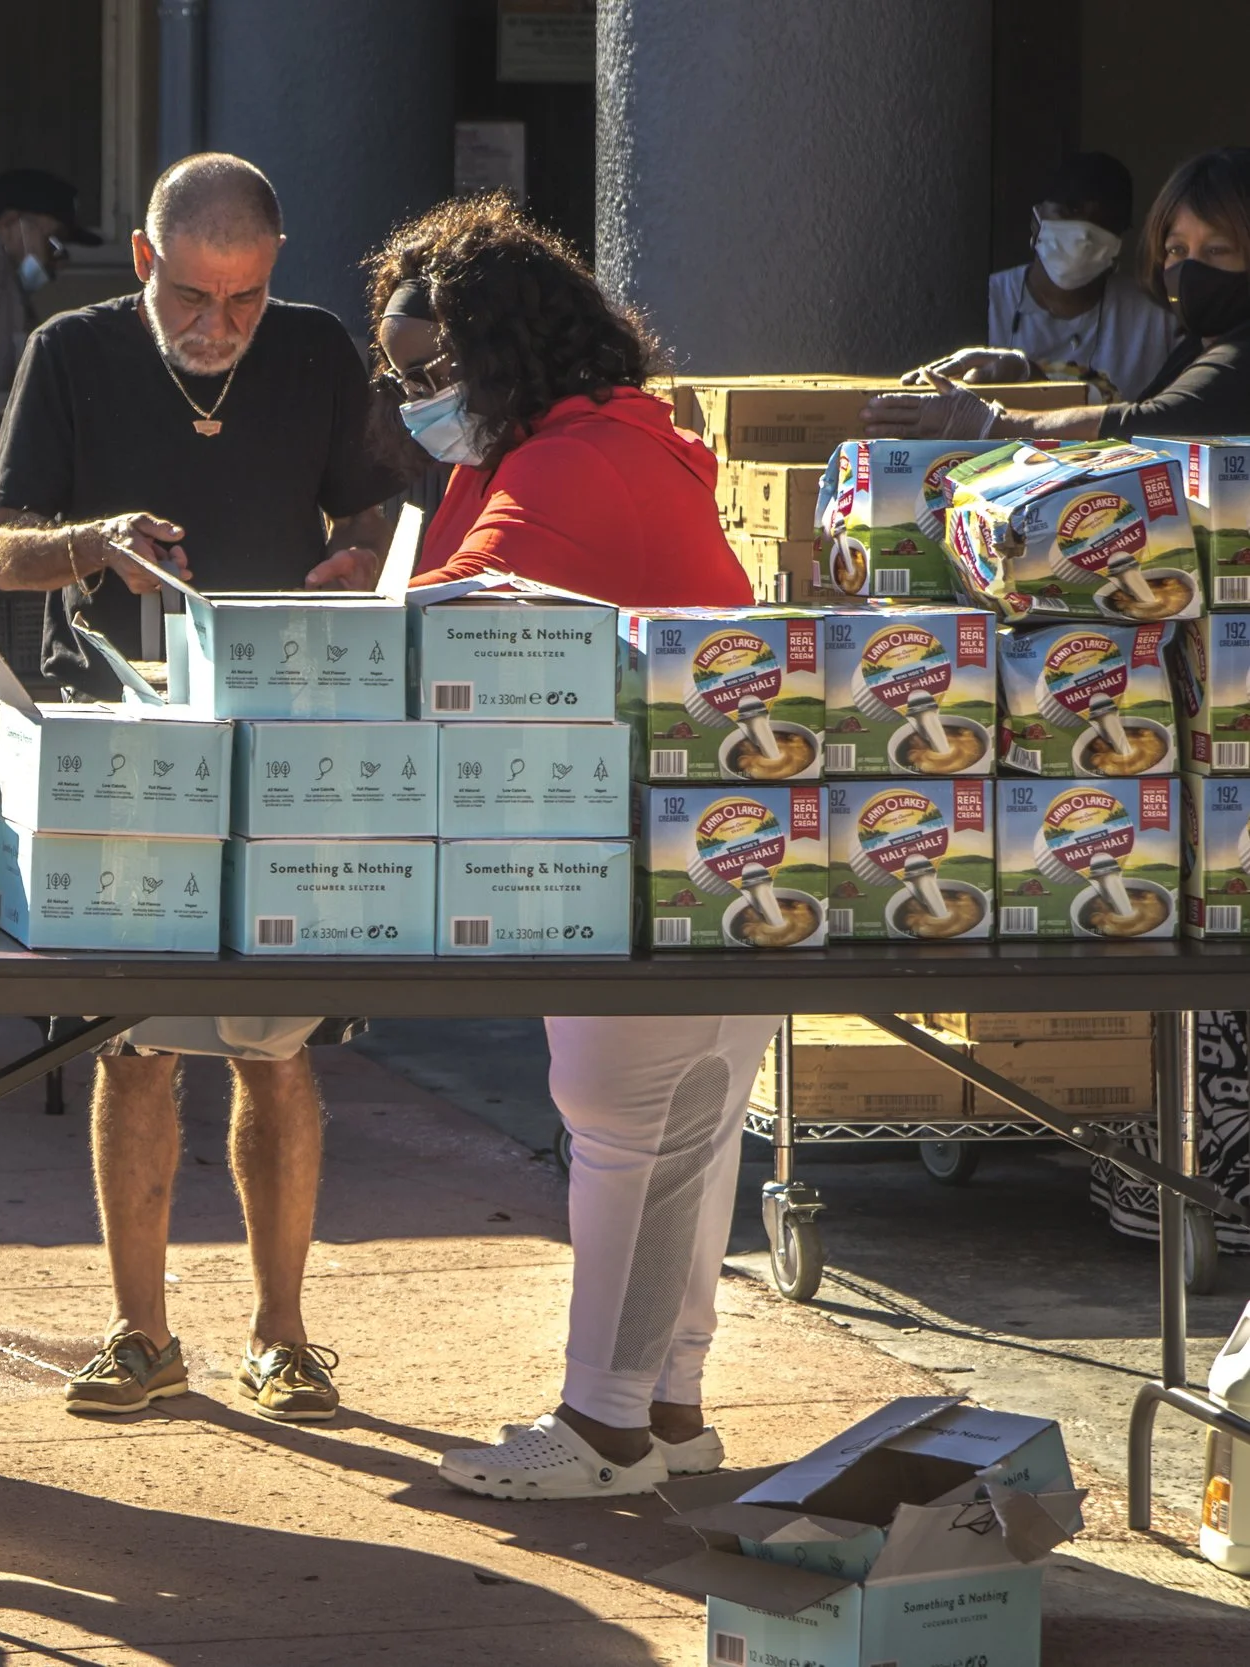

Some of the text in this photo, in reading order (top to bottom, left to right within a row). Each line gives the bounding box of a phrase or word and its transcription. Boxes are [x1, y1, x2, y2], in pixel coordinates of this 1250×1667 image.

[889, 451, 910, 466] 192
[1224, 456, 1245, 473] 192
[1145, 483, 1170, 494] REAL
[1148, 493, 1165, 501] MILK
[1149, 497, 1172, 507] CREAM
[1062, 512, 1082, 537] LAND
[1091, 497, 1118, 512] LAKES
[1081, 530, 1142, 566] HALF HALF
[447, 629, 593, 645] Something & Nothing
[661, 630, 682, 647] 192
[830, 625, 851, 642] 192
[960, 632, 985, 640] REAL
[1225, 622, 1247, 639] 192
[790, 637, 814, 646] REAL
[826, 642, 856, 650] CREAMERS
[868, 641, 890, 661] LAND
[903, 633, 930, 645] LAKES
[698, 645, 720, 666] LAND
[734, 638, 761, 650] LAKES
[1051, 648, 1072, 668] LAND
[1084, 640, 1111, 650] LAKES
[714, 677, 777, 705] HALF HALF
[883, 671, 946, 699] HALF HALF
[1066, 673, 1124, 705] HALF HALF
[478, 694, 527, 705] 12 x 330ml
[830, 789, 846, 807] 92
[957, 796, 982, 805] REAL
[1012, 788, 1033, 805] 192
[1143, 795, 1168, 804] REAL
[1217, 786, 1238, 804] 192
[664, 797, 685, 815] 192
[794, 804, 818, 813] REAL
[863, 804, 886, 825] LAND
[899, 798, 926, 810] LAKES
[1007, 805, 1038, 813] CREAMERS
[1050, 803, 1072, 823] LAND
[1085, 796, 1113, 808] LAKES
[1212, 804, 1243, 812] CREAMERS
[702, 813, 724, 834] LAND
[737, 806, 765, 818] LAKES
[879, 835, 944, 863] HALF HALF
[1065, 834, 1129, 862] HALF HALF
[717, 844, 781, 872] HALF HALF
[270, 863, 413, 878] Something & Nothing
[465, 863, 608, 878] Something & Nothing
[300, 928, 348, 939] 12 x 330ml
[496, 928, 544, 940] 12 x 330ml
[904, 1590, 1009, 1613] Something & Nothing
[922, 1618, 958, 1629] CUCUMBER
[750, 1650, 757, 1663] 12
[765, 1654, 787, 1667] 330ml
